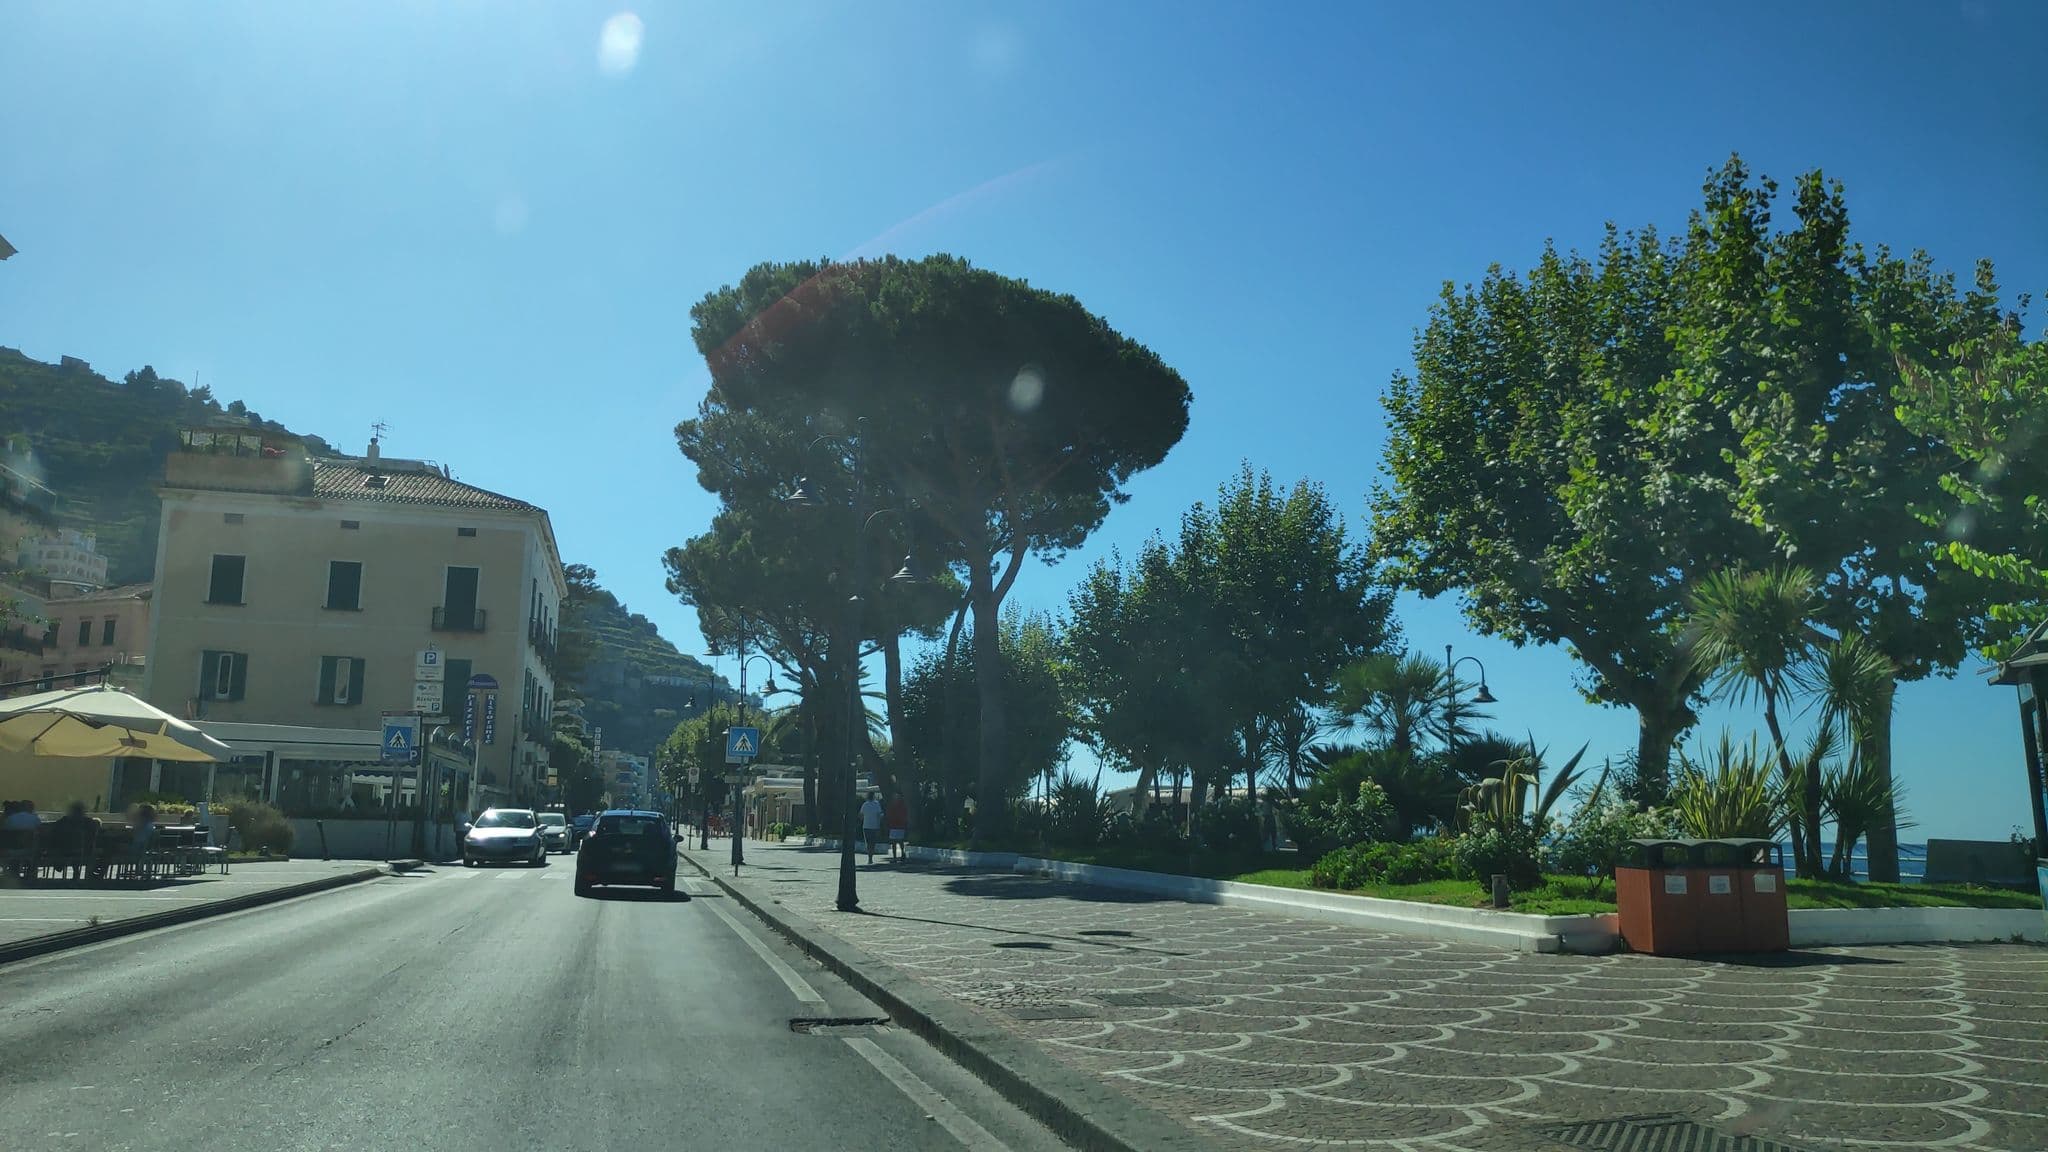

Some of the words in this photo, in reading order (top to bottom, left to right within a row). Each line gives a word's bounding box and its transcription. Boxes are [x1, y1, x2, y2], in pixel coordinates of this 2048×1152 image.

[425, 653, 436, 663] P
[464, 694, 475, 745] Pizzeri
[410, 750, 418, 760] P
